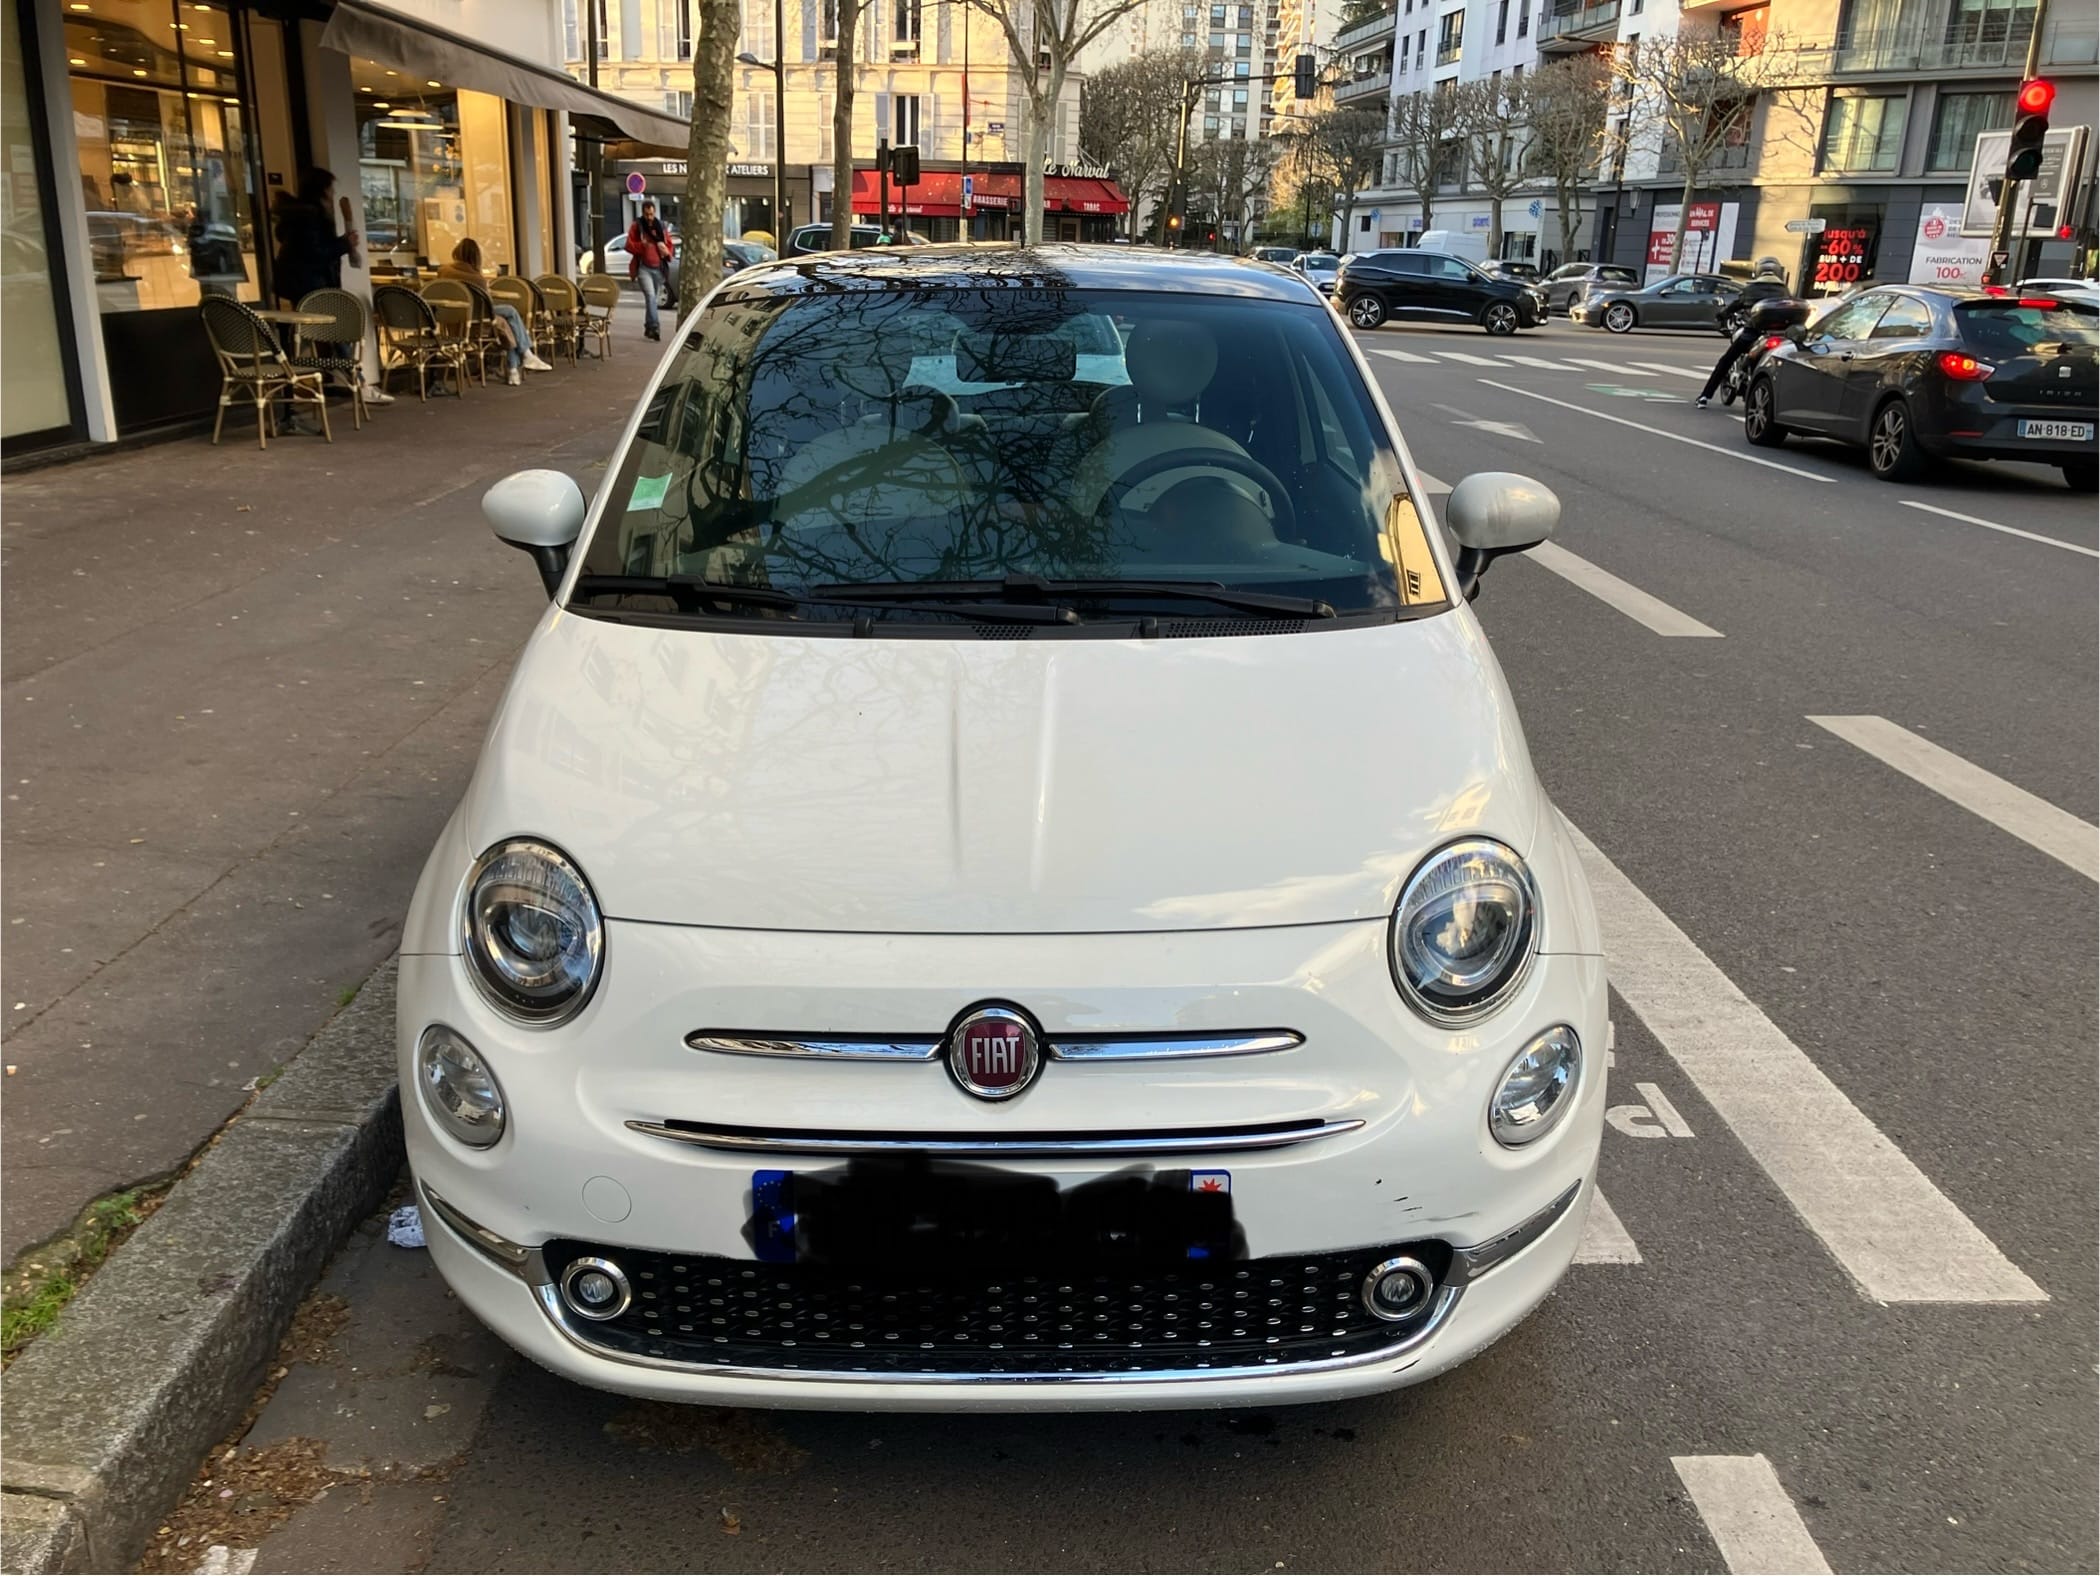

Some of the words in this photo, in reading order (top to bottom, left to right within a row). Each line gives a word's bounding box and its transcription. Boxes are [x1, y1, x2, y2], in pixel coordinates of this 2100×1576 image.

[663, 164, 678, 174] LES
[731, 165, 769, 176] ATELIERS
[1043, 157, 1057, 175] Le
[1062, 159, 1111, 179] Narval
[973, 194, 1009, 207] BRASSERIE
[1818, 254, 1838, 263] SUR
[1849, 255, 1863, 263] DE
[1925, 256, 1983, 265] FABRICATION
[1814, 263, 1859, 281] 200
[971, 1036, 1020, 1075] FIAT
